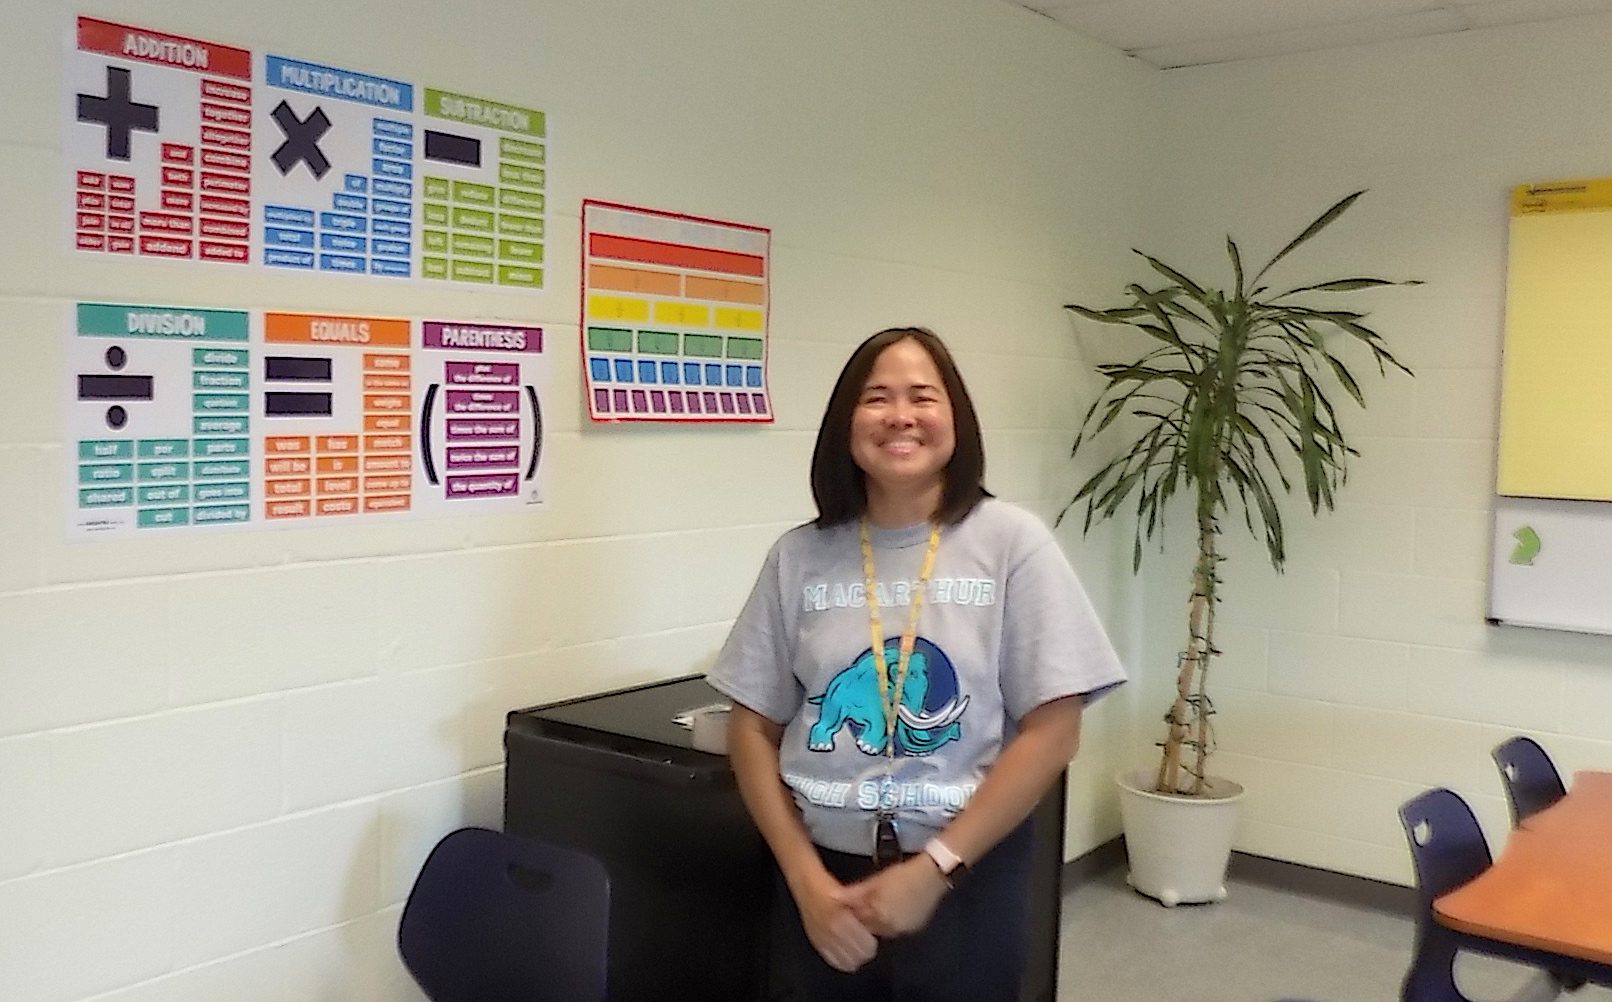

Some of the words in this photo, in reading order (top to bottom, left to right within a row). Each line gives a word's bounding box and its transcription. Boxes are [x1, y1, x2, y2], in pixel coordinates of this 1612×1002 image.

[122, 33, 209, 69] ADDITION
[281, 65, 400, 104] MULTIPLICATION
[441, 96, 528, 131] SUBTRACTION
[128, 312, 205, 336] DIVISION
[310, 320, 371, 343] EQUALS
[442, 326, 527, 350] PARENTHESIS
[506, 424, 516, 434] of
[506, 451, 517, 462] of
[503, 479, 515, 490] of
